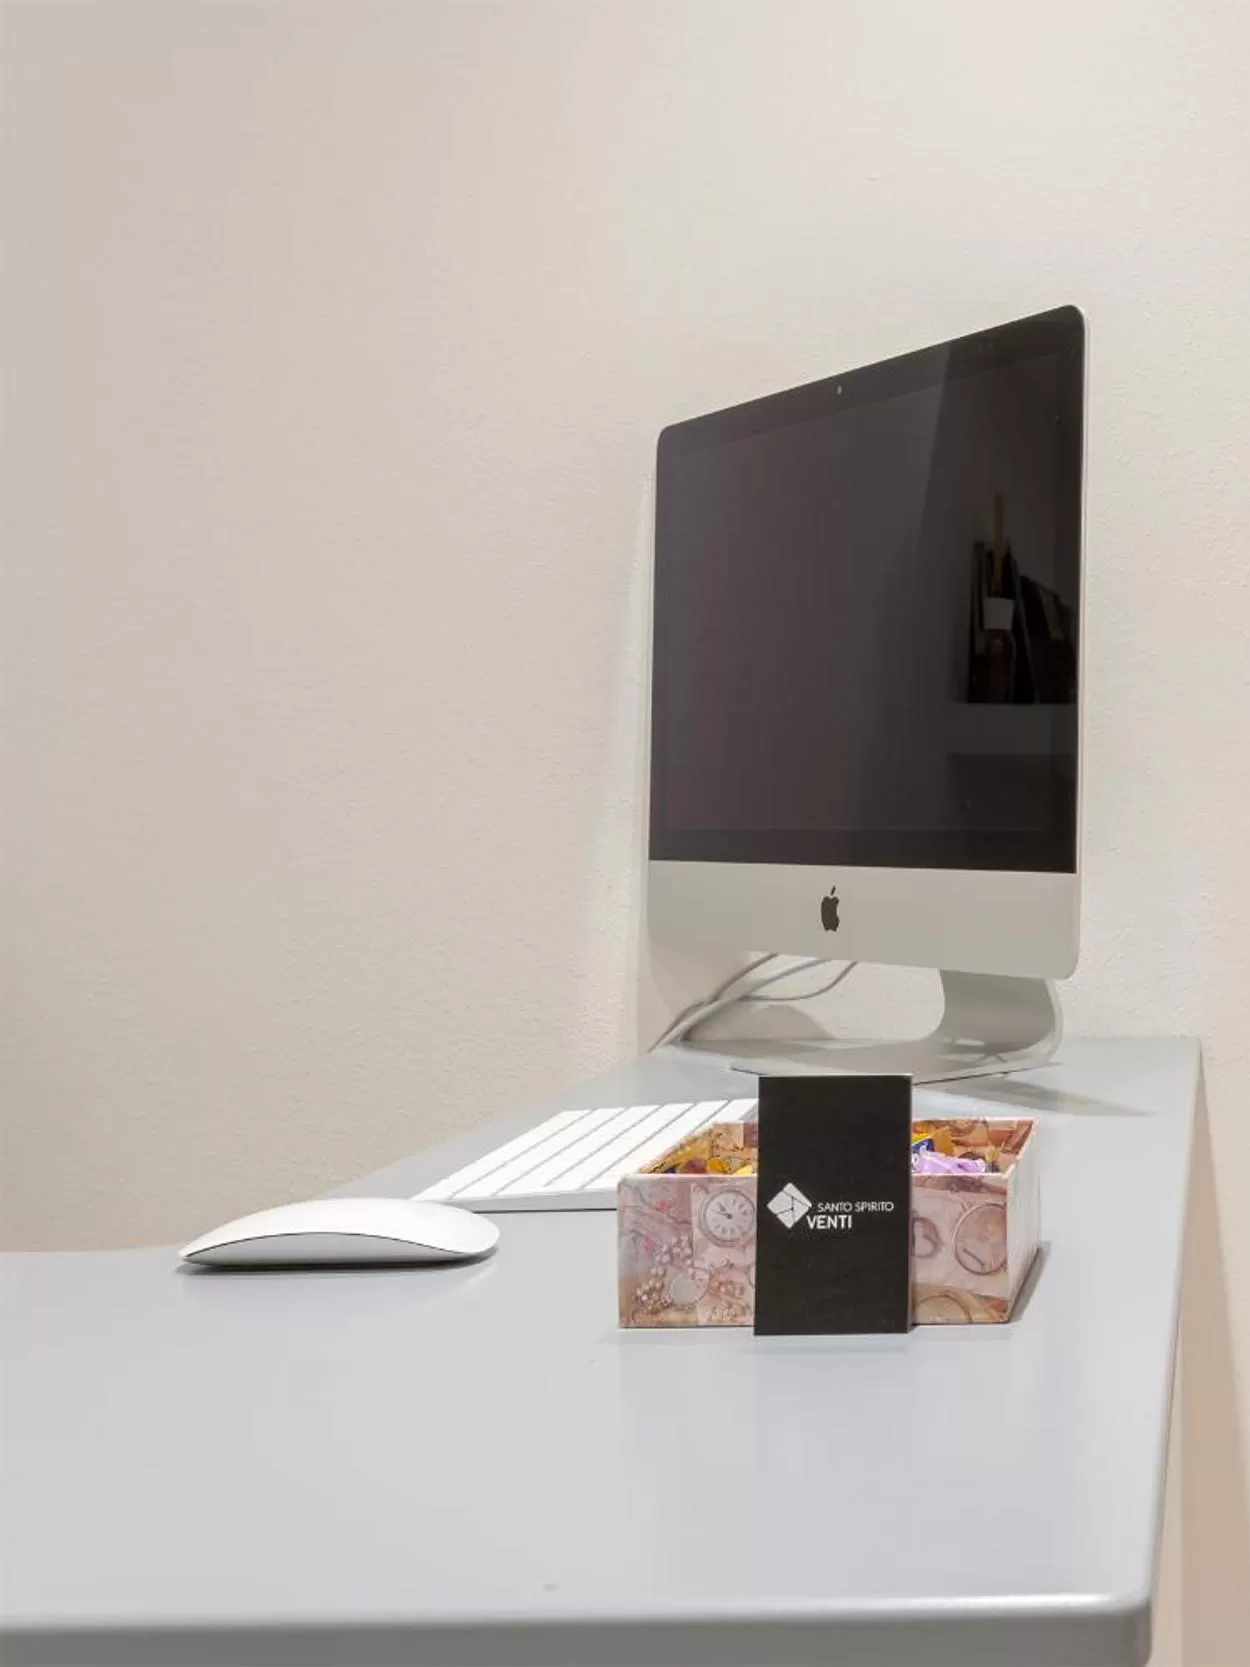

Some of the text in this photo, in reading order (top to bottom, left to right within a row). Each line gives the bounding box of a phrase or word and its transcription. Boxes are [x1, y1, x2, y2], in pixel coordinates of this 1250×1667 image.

[817, 1201, 895, 1212] SANTO SPIRITO
[806, 1214, 853, 1230] VENTI
